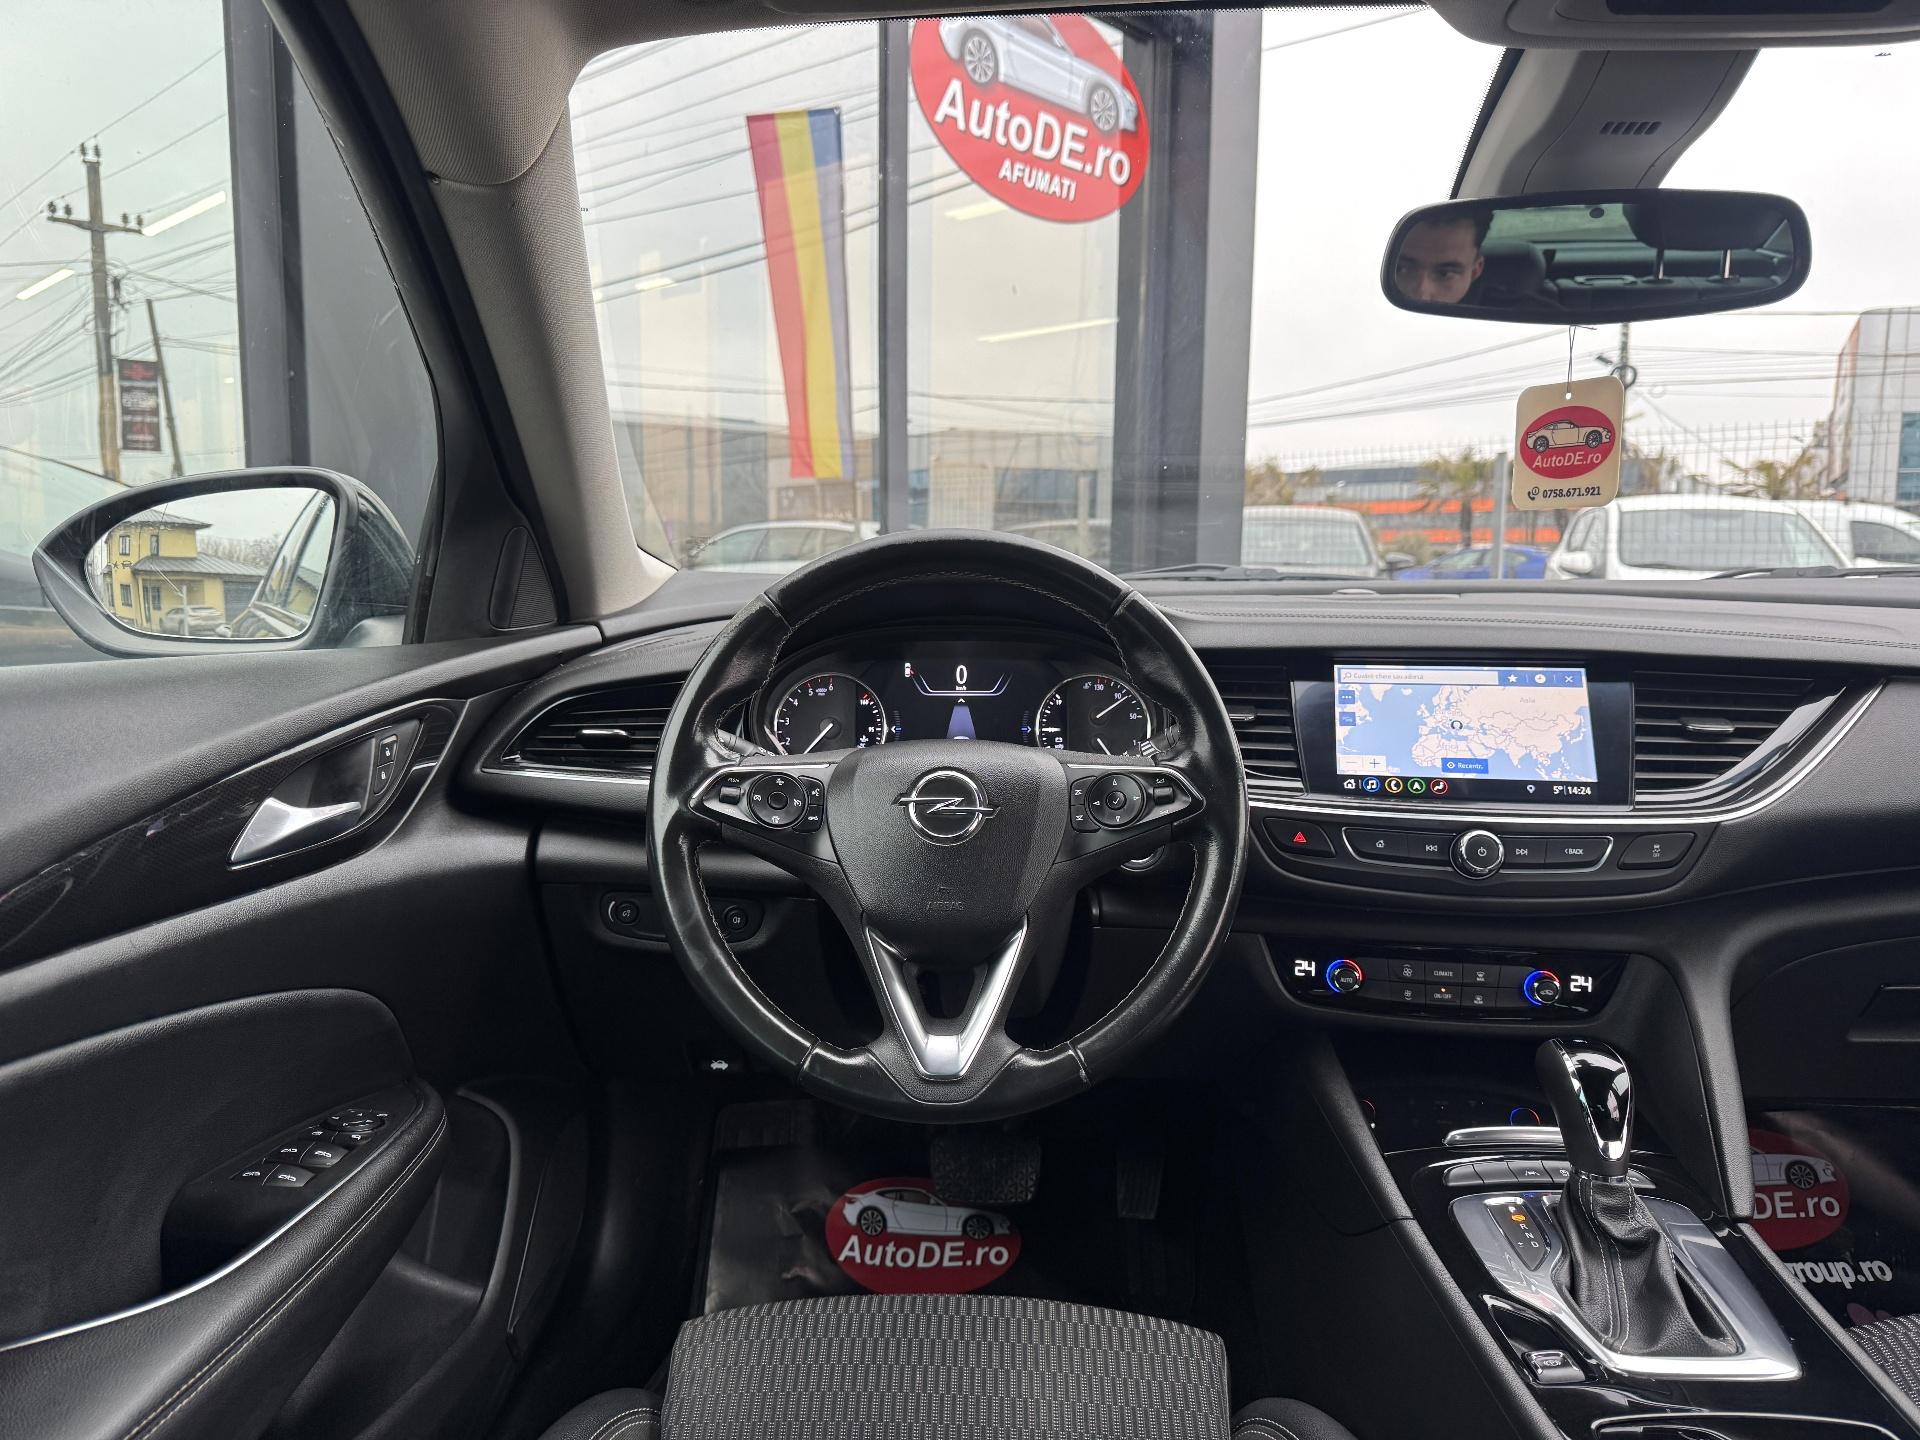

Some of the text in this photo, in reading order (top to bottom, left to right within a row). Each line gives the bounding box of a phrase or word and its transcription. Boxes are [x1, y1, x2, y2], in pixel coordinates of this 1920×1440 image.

[934, 78, 1131, 186] AutoDE.ro
[998, 158, 1076, 202] AFUMATI
[1532, 451, 1602, 469] AutoDE.ro
[1542, 486, 1601, 499] 0758.671.921
[955, 664, 968, 685] 0
[808, 688, 814, 696] 5
[829, 683, 834, 691] 6
[1115, 692, 1122, 700] 90
[793, 699, 799, 707] 4
[785, 717, 790, 726] 3
[785, 737, 791, 746] 2
[1567, 786, 1592, 796] 14:24
[1294, 959, 1316, 977] 24
[1569, 975, 1592, 993] 24
[837, 1235, 1010, 1269] AutoDE.ro
